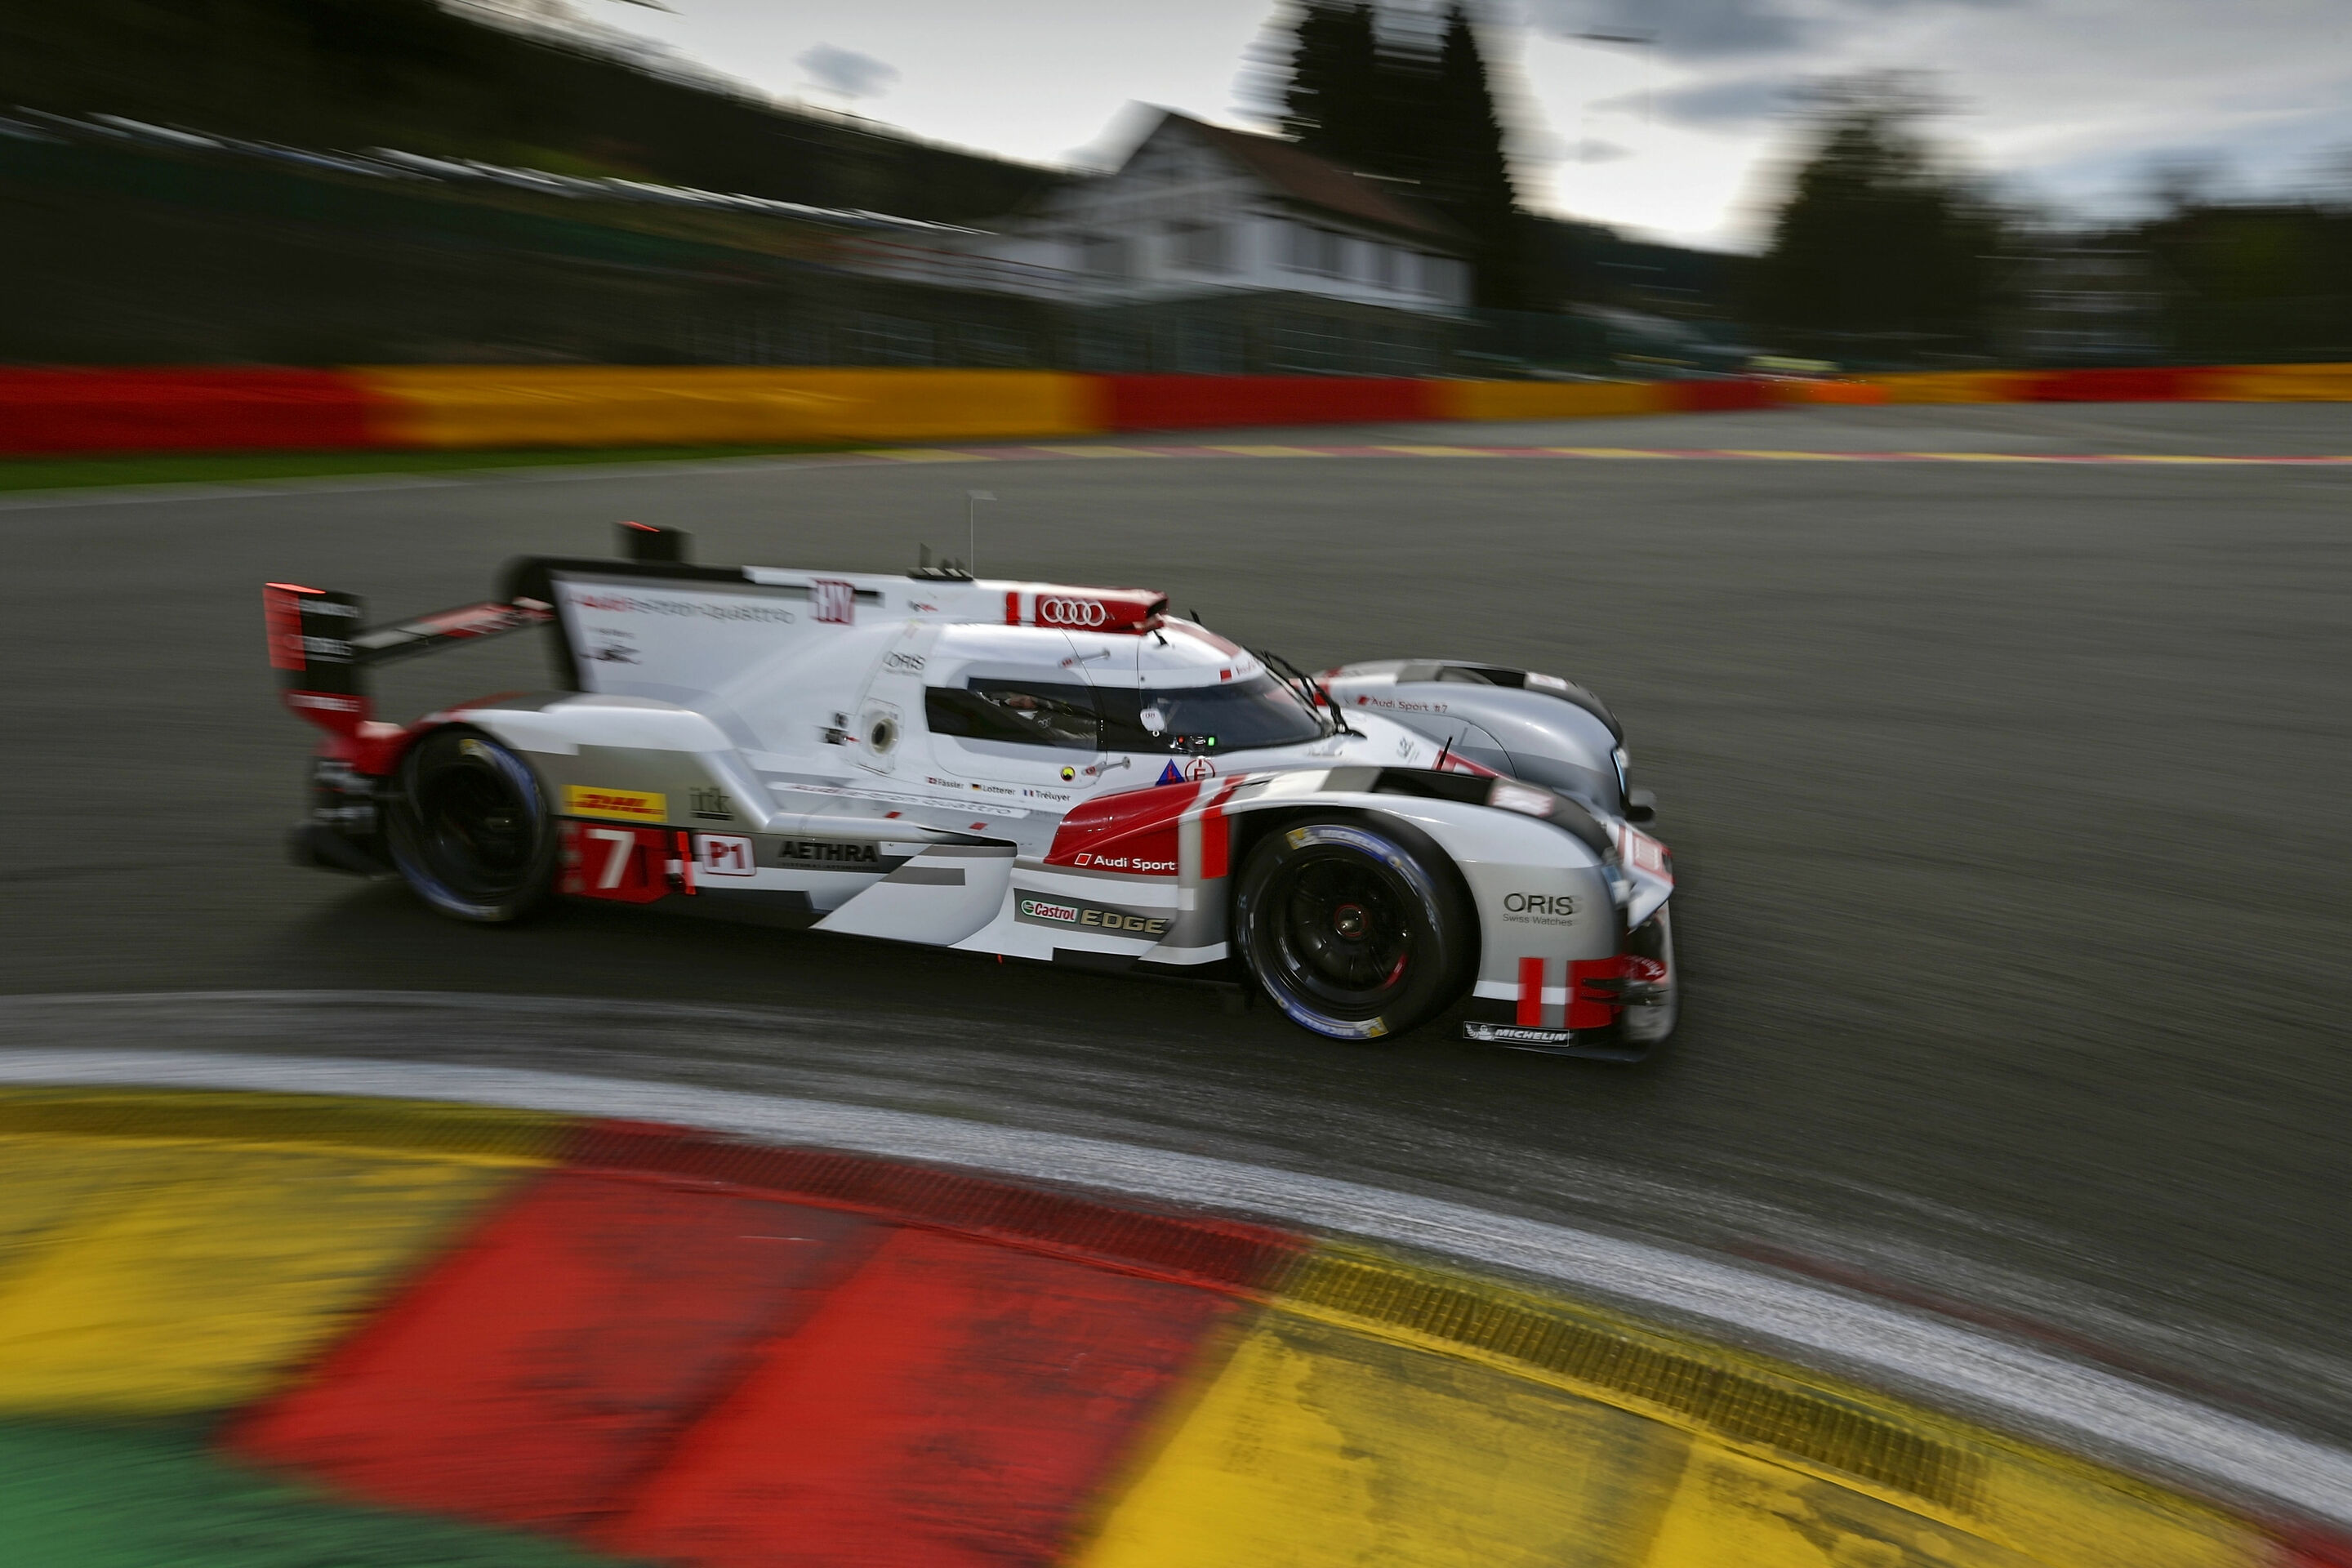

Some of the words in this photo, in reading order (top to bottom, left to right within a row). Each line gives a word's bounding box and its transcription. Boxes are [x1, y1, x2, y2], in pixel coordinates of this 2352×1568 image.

[1371, 697, 1396, 708] Audi
[1398, 701, 1429, 713] Sport
[1433, 704, 1449, 714] #7
[983, 784, 1017, 795] Lotterer
[1036, 789, 1071, 802] Tréluyer
[586, 828, 636, 889] 7
[709, 840, 746, 871] P1
[777, 840, 880, 863] AETHRA
[1094, 855, 1128, 868] Audi
[1132, 858, 1176, 871] Sport
[1034, 902, 1076, 921] Castrol
[1503, 893, 1574, 916] ORIS
[1080, 908, 1169, 934] EDGE
[1503, 914, 1530, 924] Swiss
[1533, 916, 1573, 927] Watches
[1494, 1028, 1567, 1042] MICHELIN
